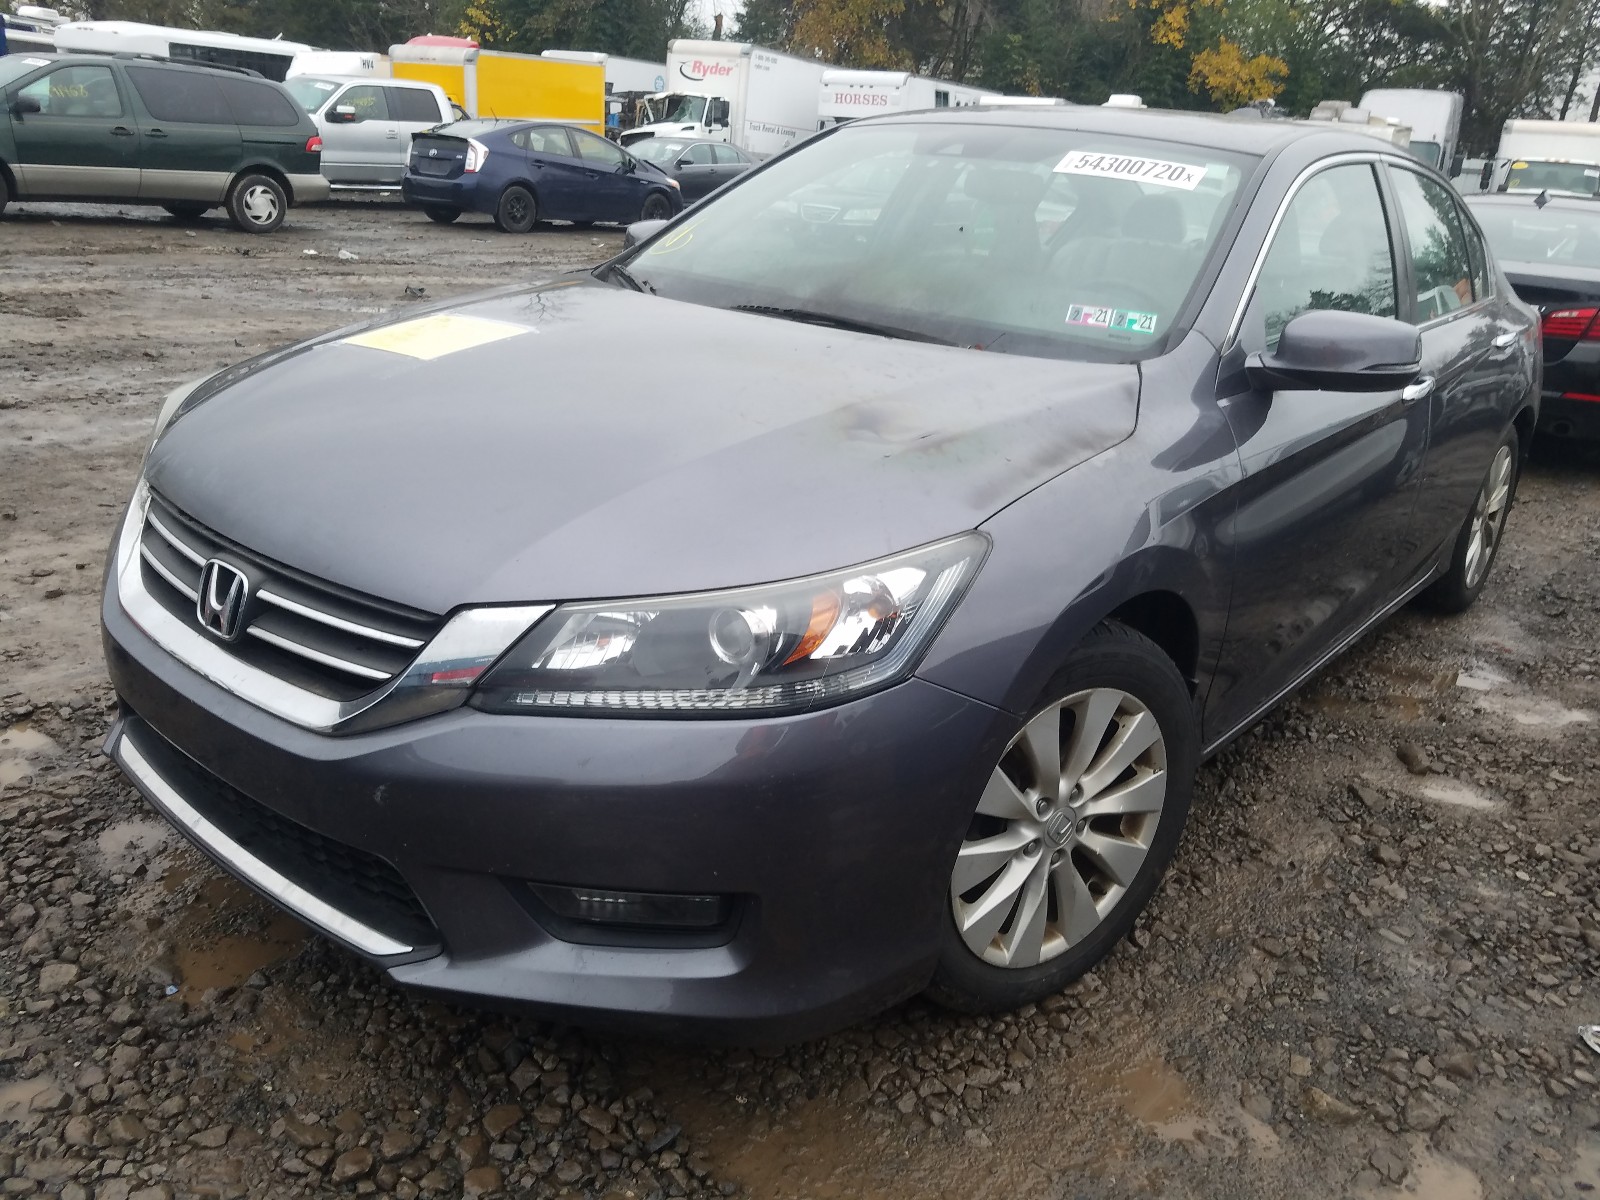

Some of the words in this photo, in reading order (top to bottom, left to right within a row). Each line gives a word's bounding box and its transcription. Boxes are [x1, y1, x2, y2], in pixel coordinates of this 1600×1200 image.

[691, 60, 733, 78] Ryder
[834, 93, 888, 106] HORSES
[1072, 309, 1081, 321] 2
[1095, 308, 1108, 323] 21
[1140, 315, 1153, 330] 21
